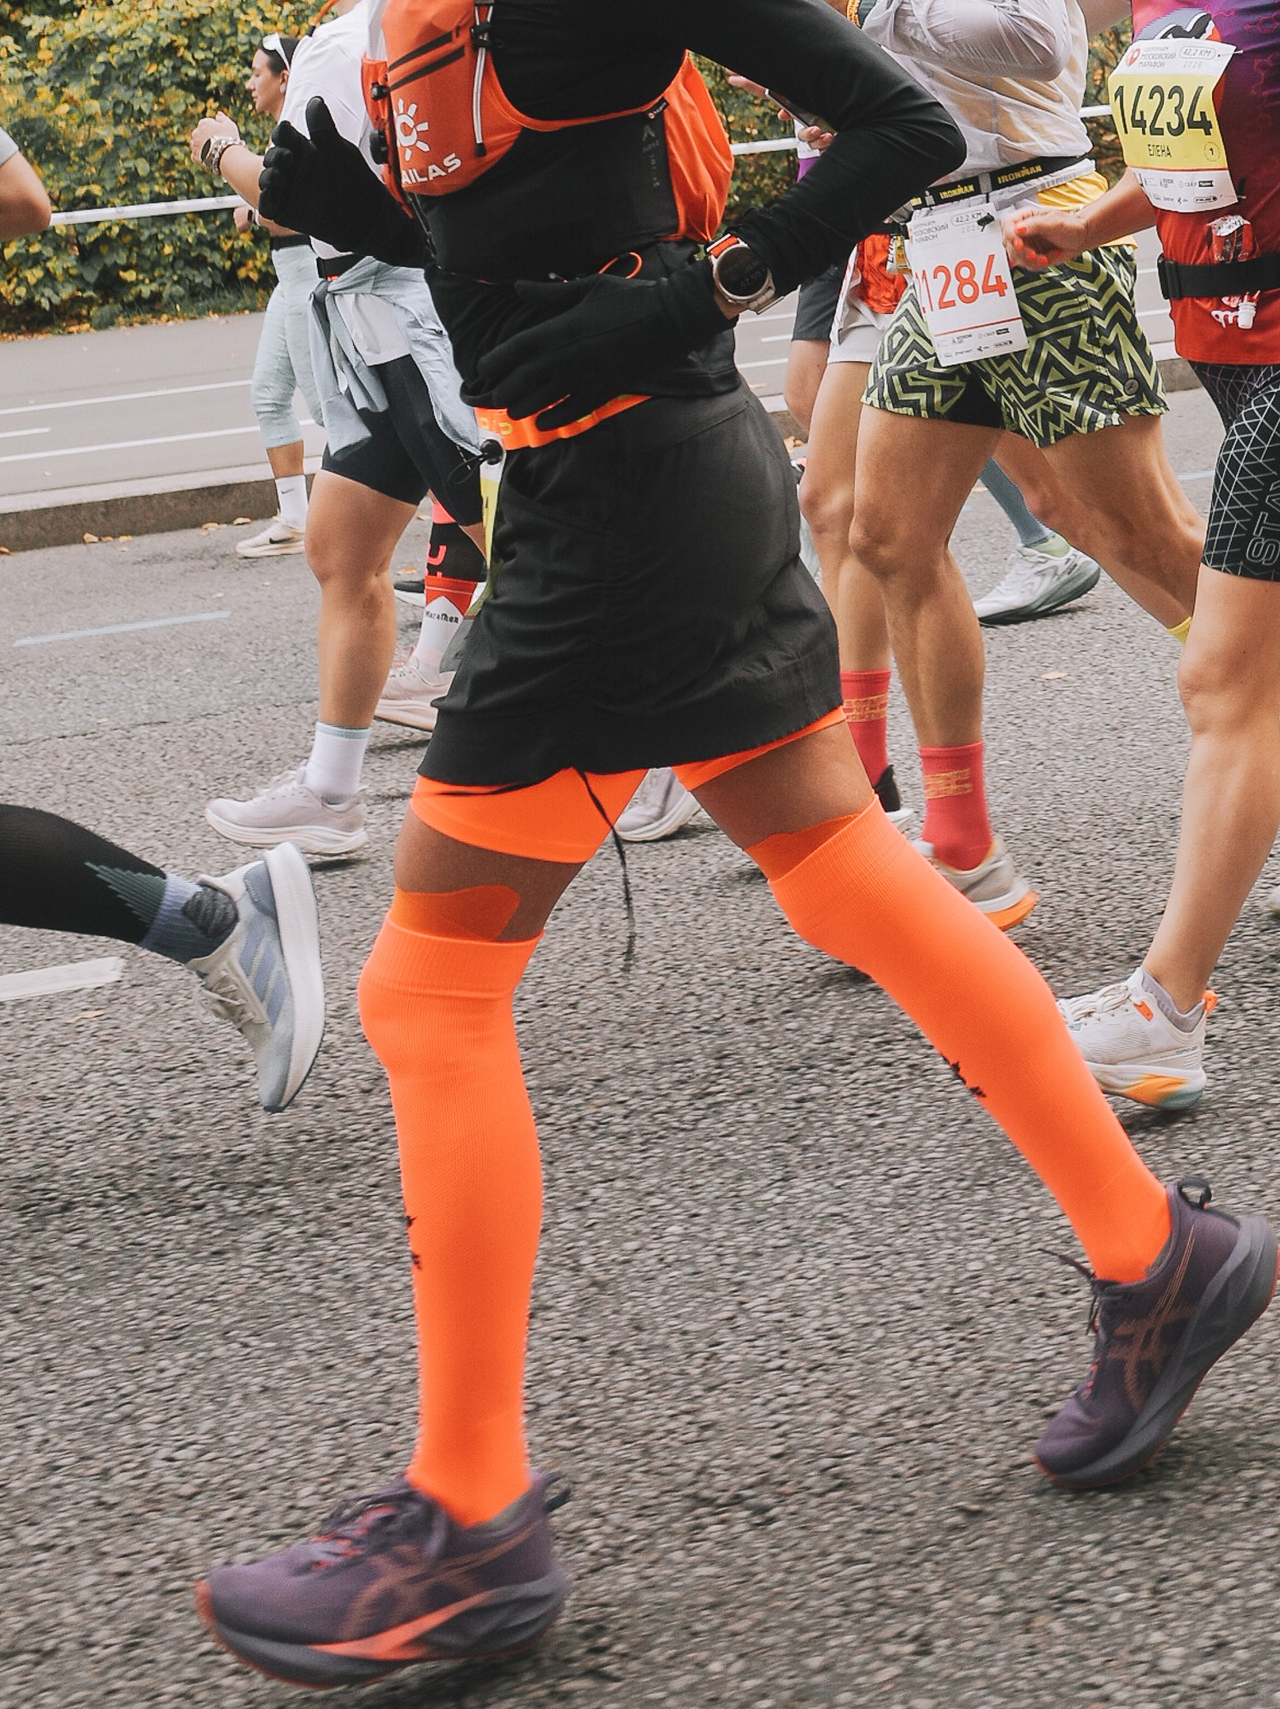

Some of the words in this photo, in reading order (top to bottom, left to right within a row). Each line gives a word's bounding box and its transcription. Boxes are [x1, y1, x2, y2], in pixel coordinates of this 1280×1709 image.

[1113, 84, 1213, 137] 14234
[1148, 143, 1173, 158] ЕЛЕНА
[998, 165, 1042, 184] IRONMAN
[940, 184, 975, 200] IRONMAN
